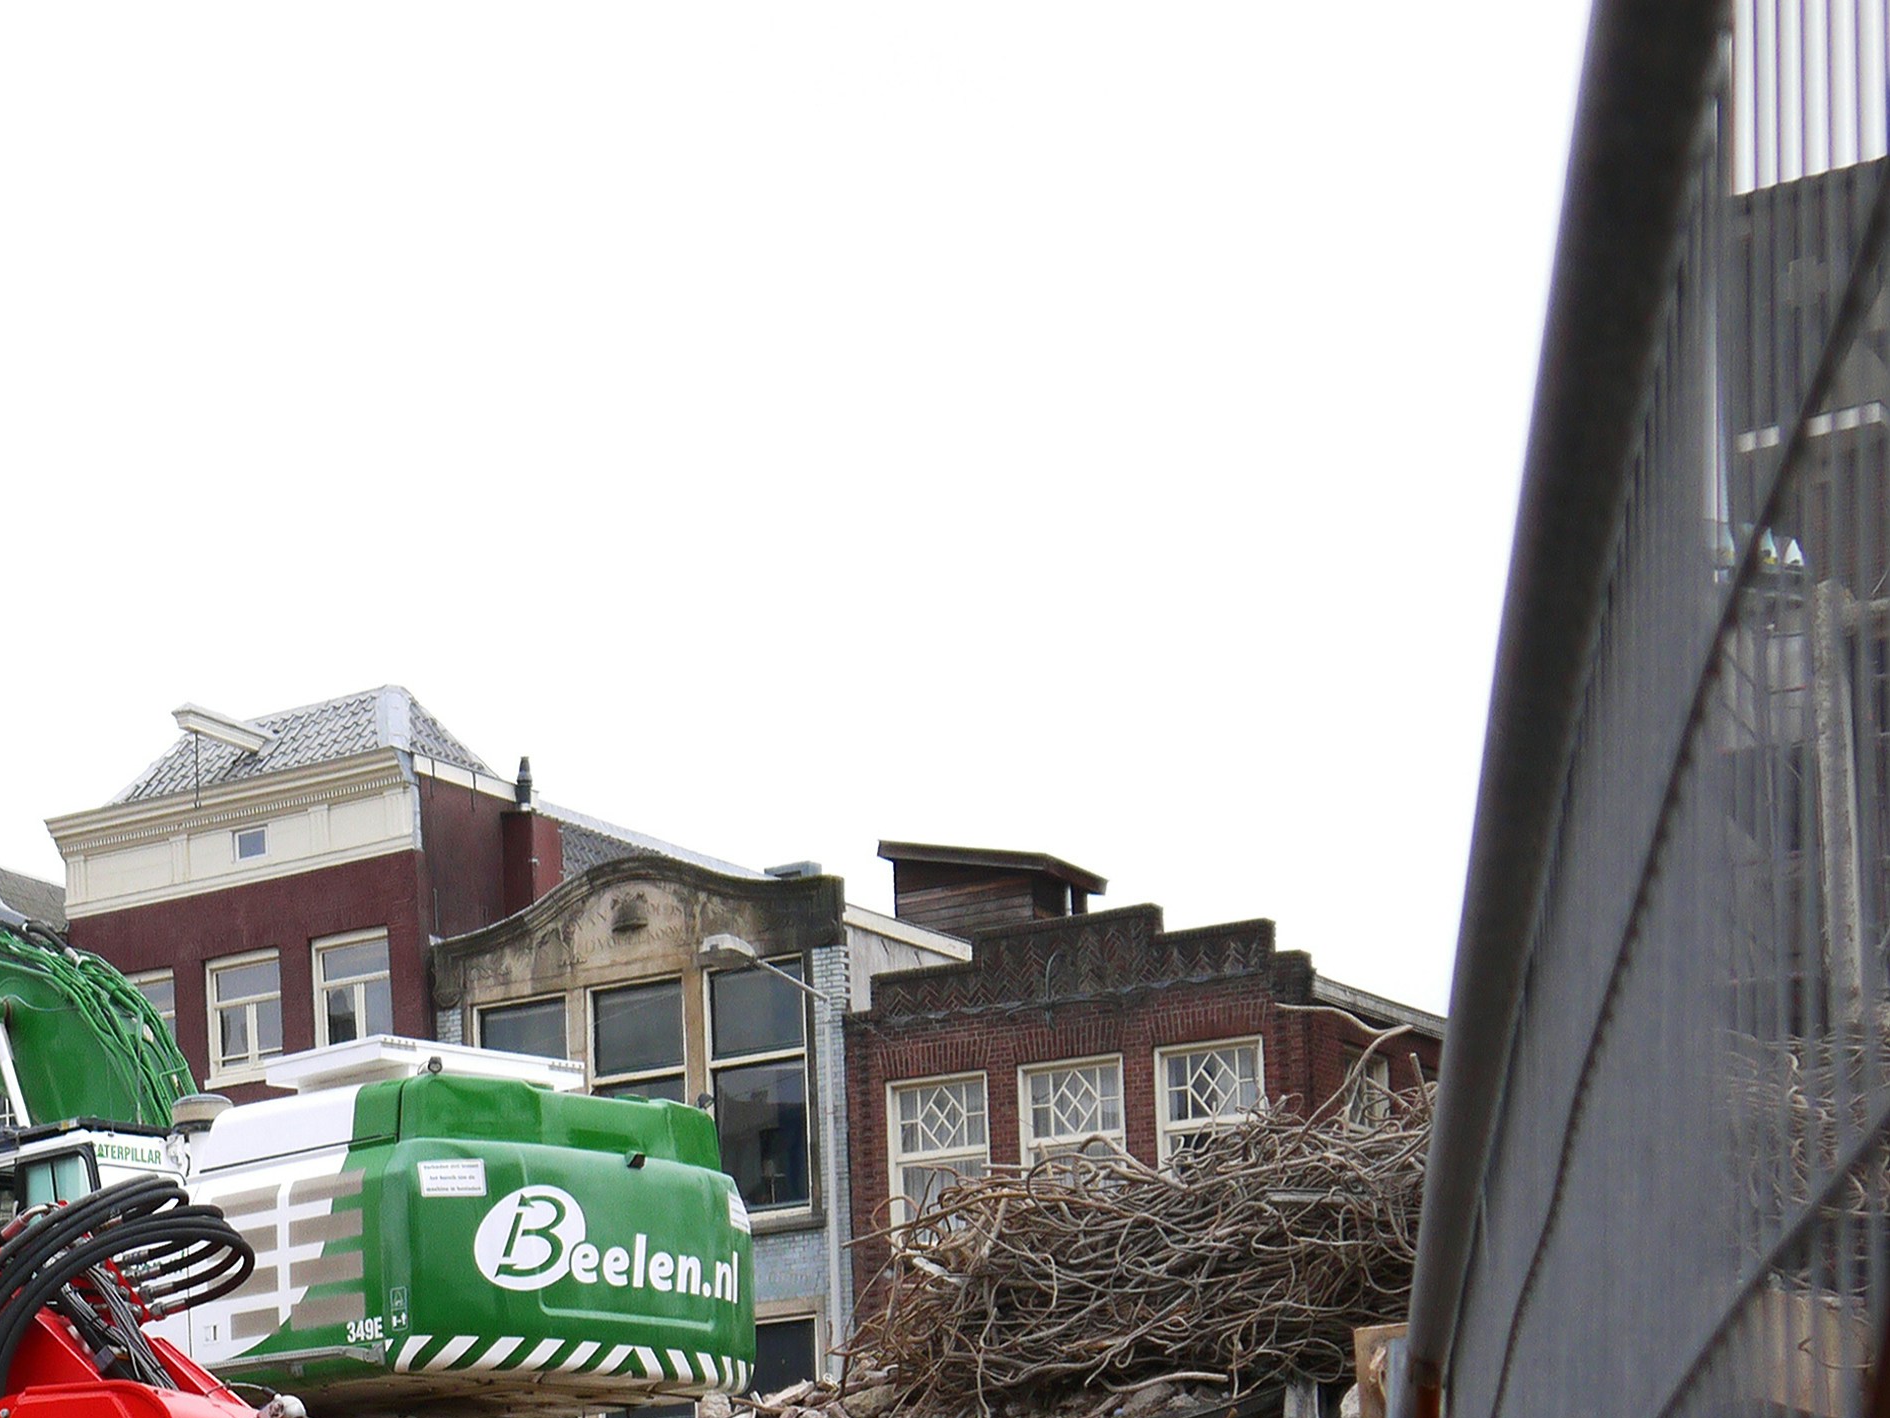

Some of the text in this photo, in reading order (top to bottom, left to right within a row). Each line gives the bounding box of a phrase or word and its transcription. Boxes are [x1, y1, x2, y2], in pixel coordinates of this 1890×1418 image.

[94, 1143, 162, 1165] ATERPILLAR
[488, 1190, 739, 1304] Beelen.nl
[346, 1315, 384, 1343] 349E
